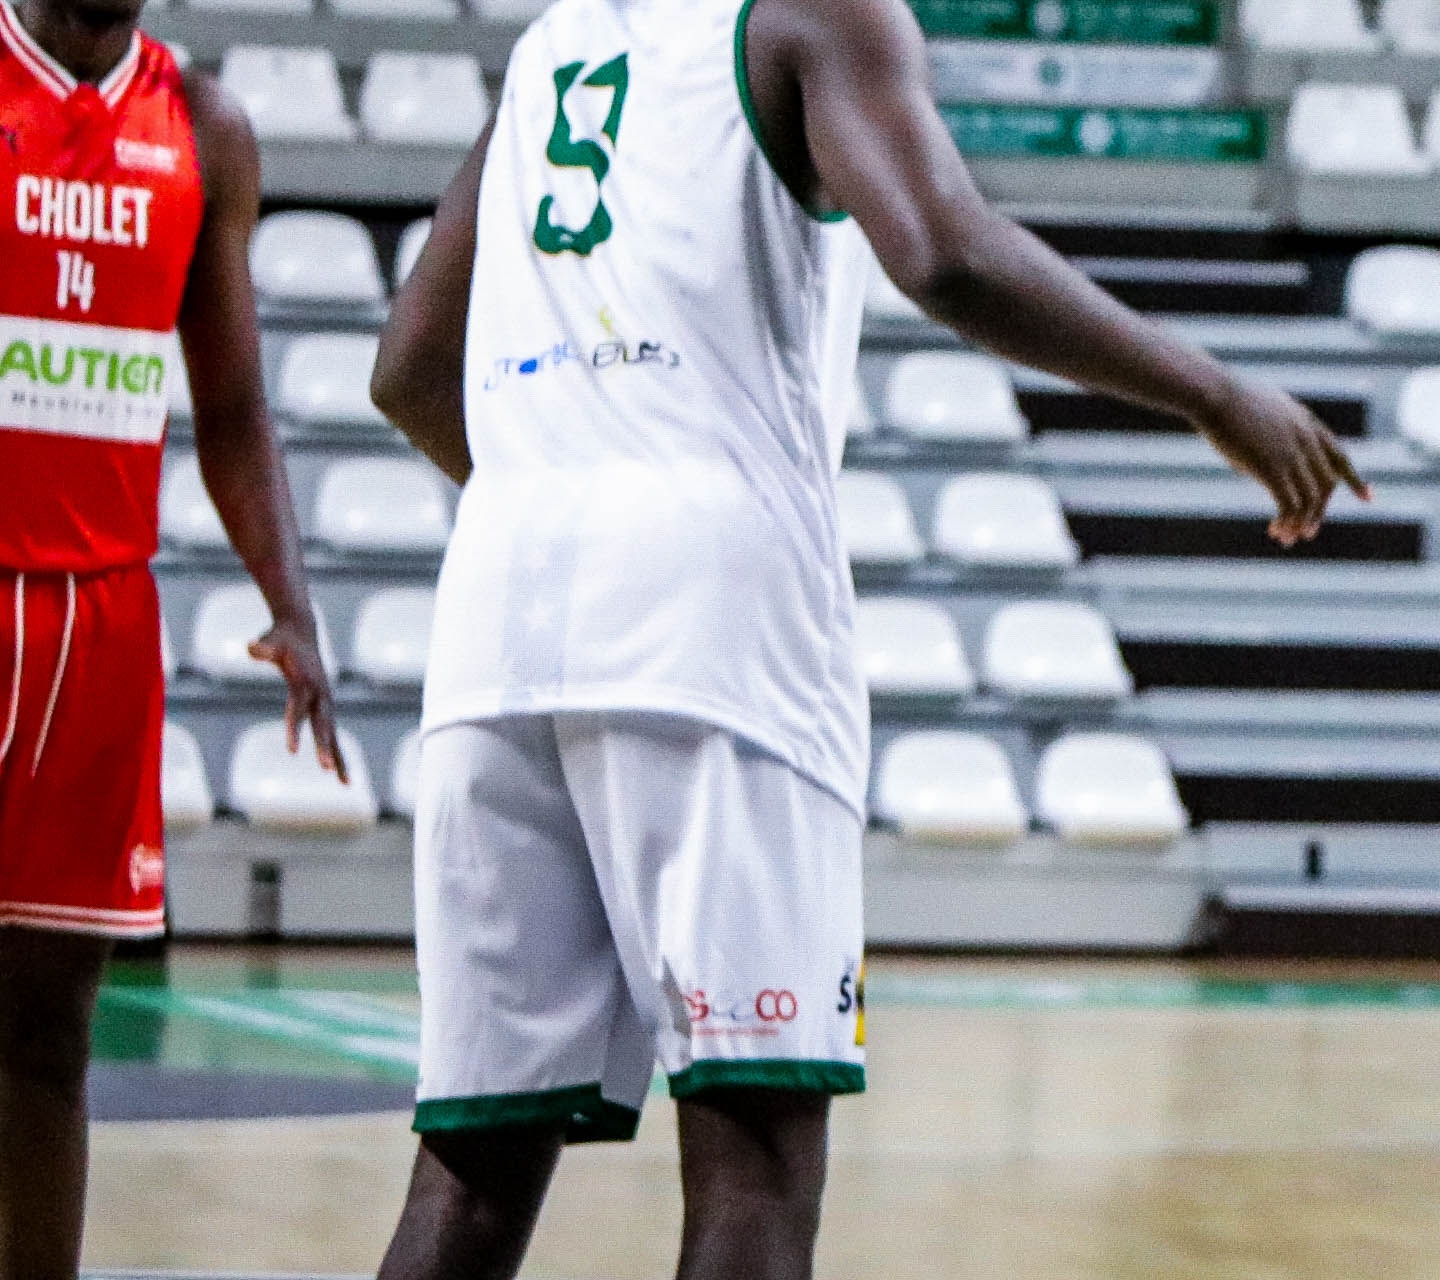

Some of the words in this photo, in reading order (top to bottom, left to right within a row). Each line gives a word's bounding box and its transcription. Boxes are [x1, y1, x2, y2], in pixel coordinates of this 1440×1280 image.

[16, 174, 154, 250] CHOLET
[56, 248, 96, 313] 14
[0, 340, 164, 397] AUTIER
